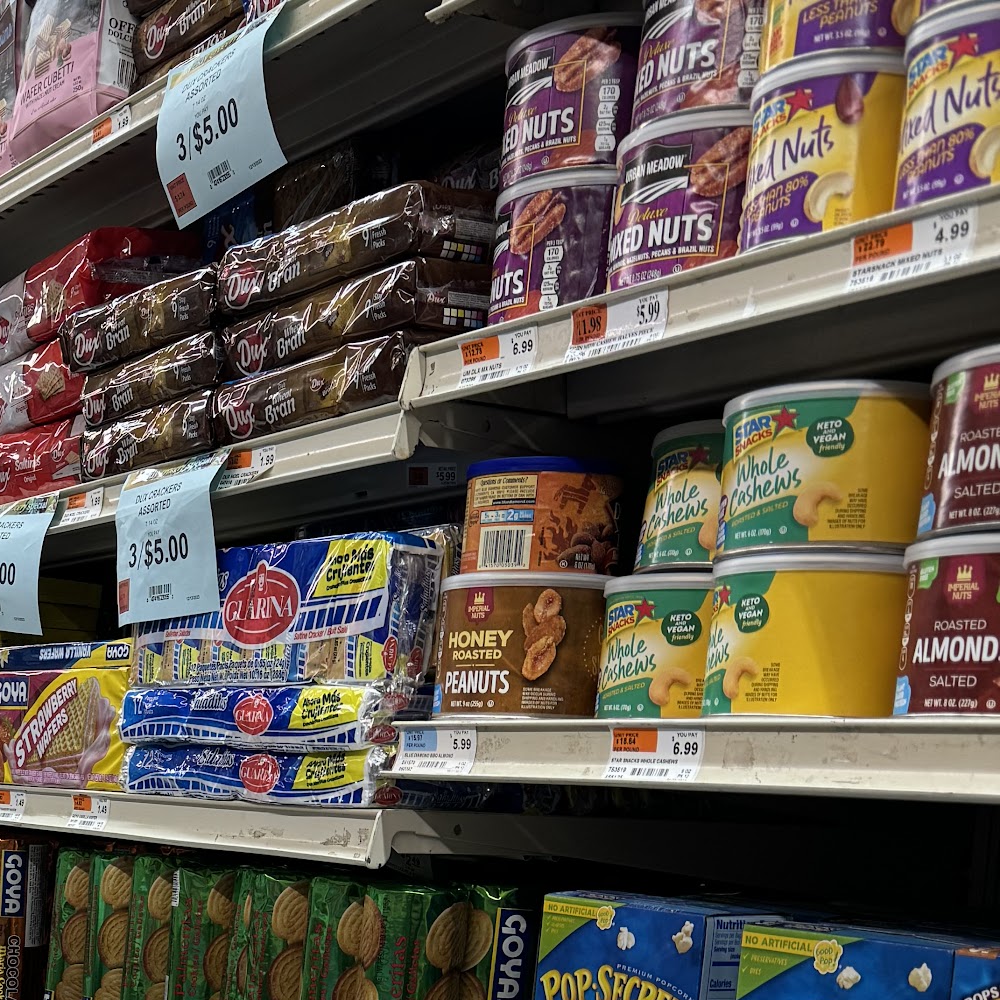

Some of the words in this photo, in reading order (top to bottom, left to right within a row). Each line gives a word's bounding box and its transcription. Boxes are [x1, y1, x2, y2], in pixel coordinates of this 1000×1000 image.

[146, 18, 170, 52] Dux
[518, 57, 550, 78] MEADOW
[656, 39, 718, 77] NUTS
[43, 61, 75, 91] CUBETTI
[602, 86, 616, 96] 170
[522, 107, 574, 142] NUTS
[782, 115, 835, 170] Nuts
[646, 154, 684, 178] MEADOW
[627, 206, 668, 226] Deluxe
[650, 213, 713, 249] NUTS
[935, 221, 969, 243] 4.99
[267, 260, 300, 293] Bran
[74, 331, 100, 359] Dux
[106, 325, 130, 350] Bran
[237, 337, 267, 368] Dux
[277, 331, 306, 358] Bran
[513, 339, 533, 355] 6.99
[223, 403, 256, 432] Dux
[265, 397, 296, 425] Bran
[816, 420, 842, 430] KETO
[735, 415, 773, 440] STAR
[813, 431, 846, 444] VEGAN
[735, 428, 773, 457] SNACKS
[819, 441, 845, 454] friendly
[737, 446, 789, 487] Whole
[655, 478, 700, 512] Whole
[729, 468, 802, 517] Cashews
[138, 498, 171, 517] ASSORTED
[646, 498, 708, 538] Cashews
[128, 532, 189, 570] 3/$5.00
[947, 582, 979, 592] IMPERIAL
[952, 591, 972, 600] NUTS
[225, 595, 295, 622] GUARINA
[467, 605, 490, 613] IMPERIAL
[608, 603, 635, 623] STAR
[741, 597, 760, 607] KETO
[670, 613, 692, 621] KETO
[739, 609, 763, 620] VEGAN
[934, 620, 987, 631] ROASTED
[607, 615, 635, 637] SNACKS
[667, 624, 695, 634] VEGAN
[671, 632, 694, 641] friendly
[448, 630, 514, 649] HONEY
[607, 631, 648, 660] Whole
[452, 649, 502, 660] ROASTED
[445, 670, 510, 694] PEANUTS
[601, 653, 657, 689] Cashews
[929, 675, 977, 688] SALTED
[958, 699, 977, 708] (227g)
[14, 678, 77, 769] STRAWBERRY
[36, 707, 68, 758] WAFERS
[452, 738, 471, 750] 5.99
[673, 742, 698, 755] 6.99
[3, 853, 23, 916] GOYA
[745, 935, 760, 945] NO
[761, 938, 813, 953] ARTIFICIAL
[497, 914, 527, 999] GOYA
